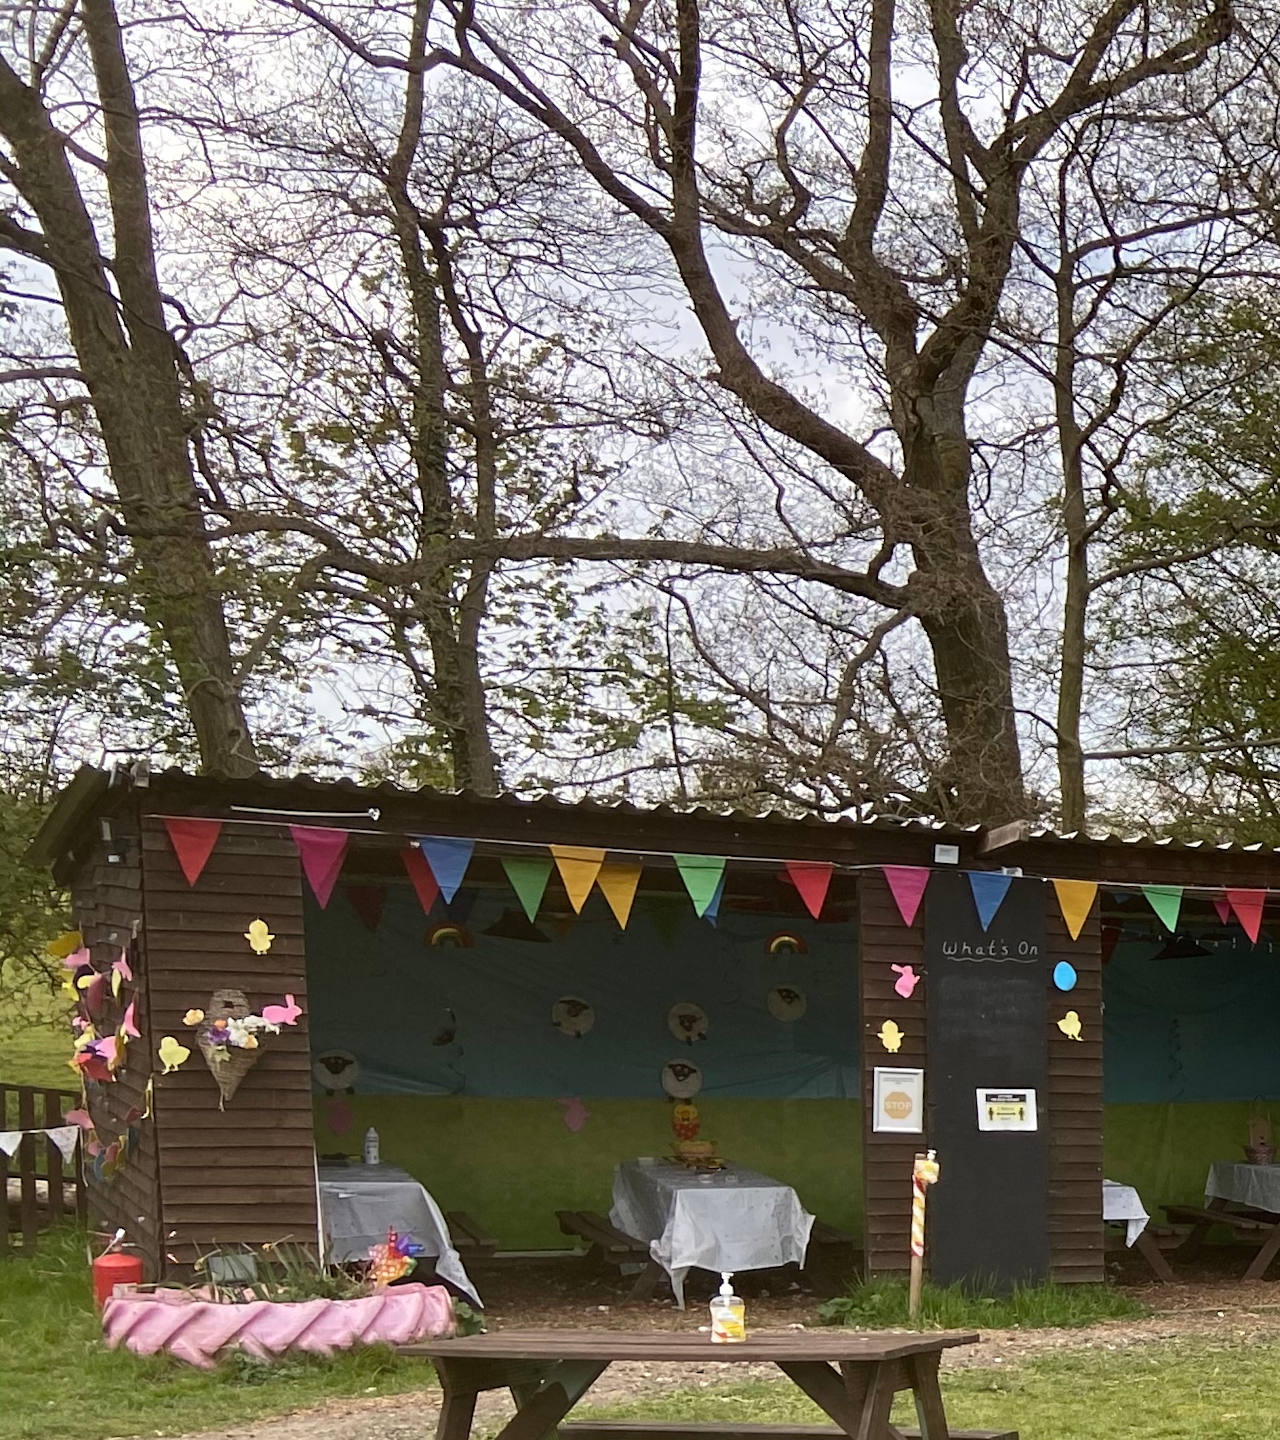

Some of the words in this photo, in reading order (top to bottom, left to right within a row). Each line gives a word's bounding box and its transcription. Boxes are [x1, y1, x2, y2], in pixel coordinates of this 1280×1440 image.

[942, 939, 1009, 956] What's
[1018, 941, 1039, 956] On
[885, 1100, 912, 1111] STOP
